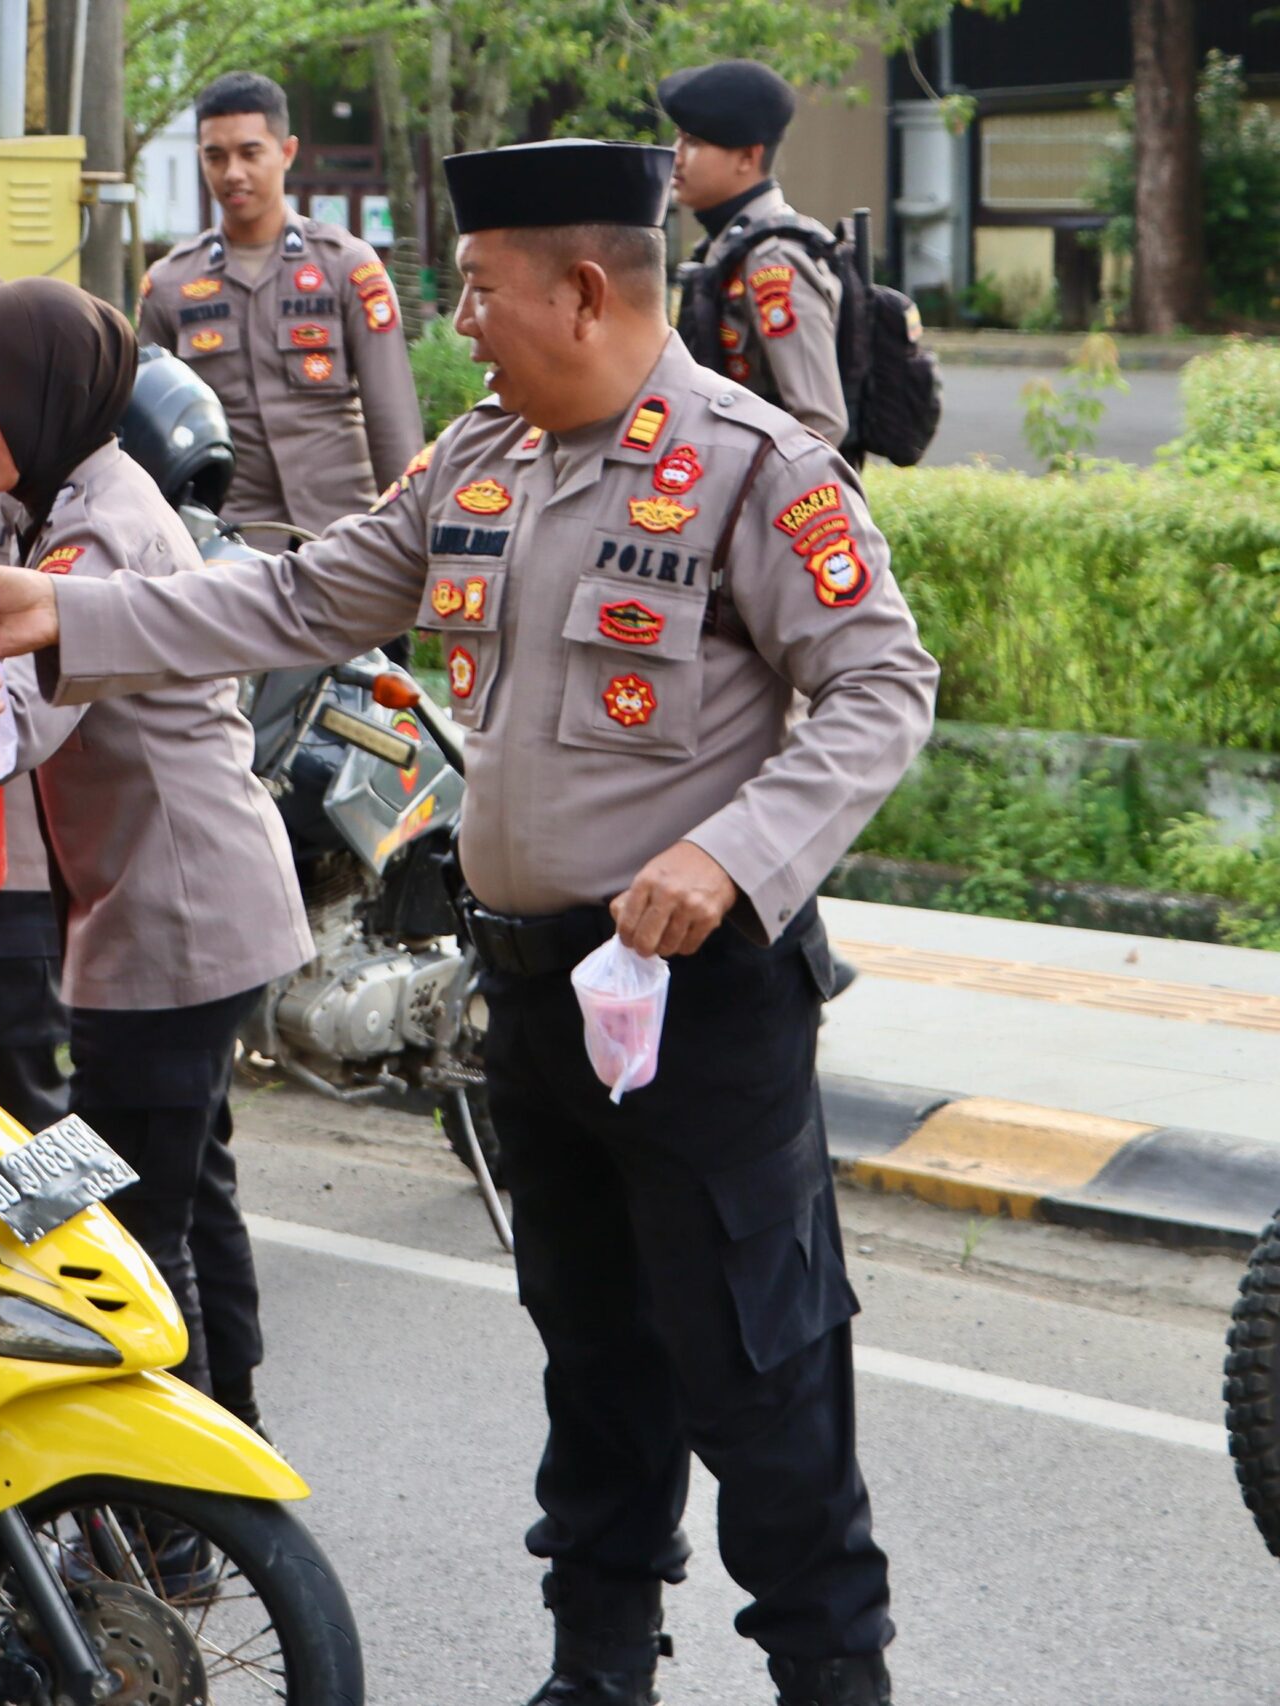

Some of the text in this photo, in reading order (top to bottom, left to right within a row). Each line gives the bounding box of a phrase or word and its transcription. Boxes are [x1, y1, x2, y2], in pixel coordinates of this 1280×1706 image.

[283, 299, 334, 316] POLRI
[781, 486, 837, 528] POLRES
[596, 541, 699, 586] POLRI
[7, 1131, 75, 1196] 3765
